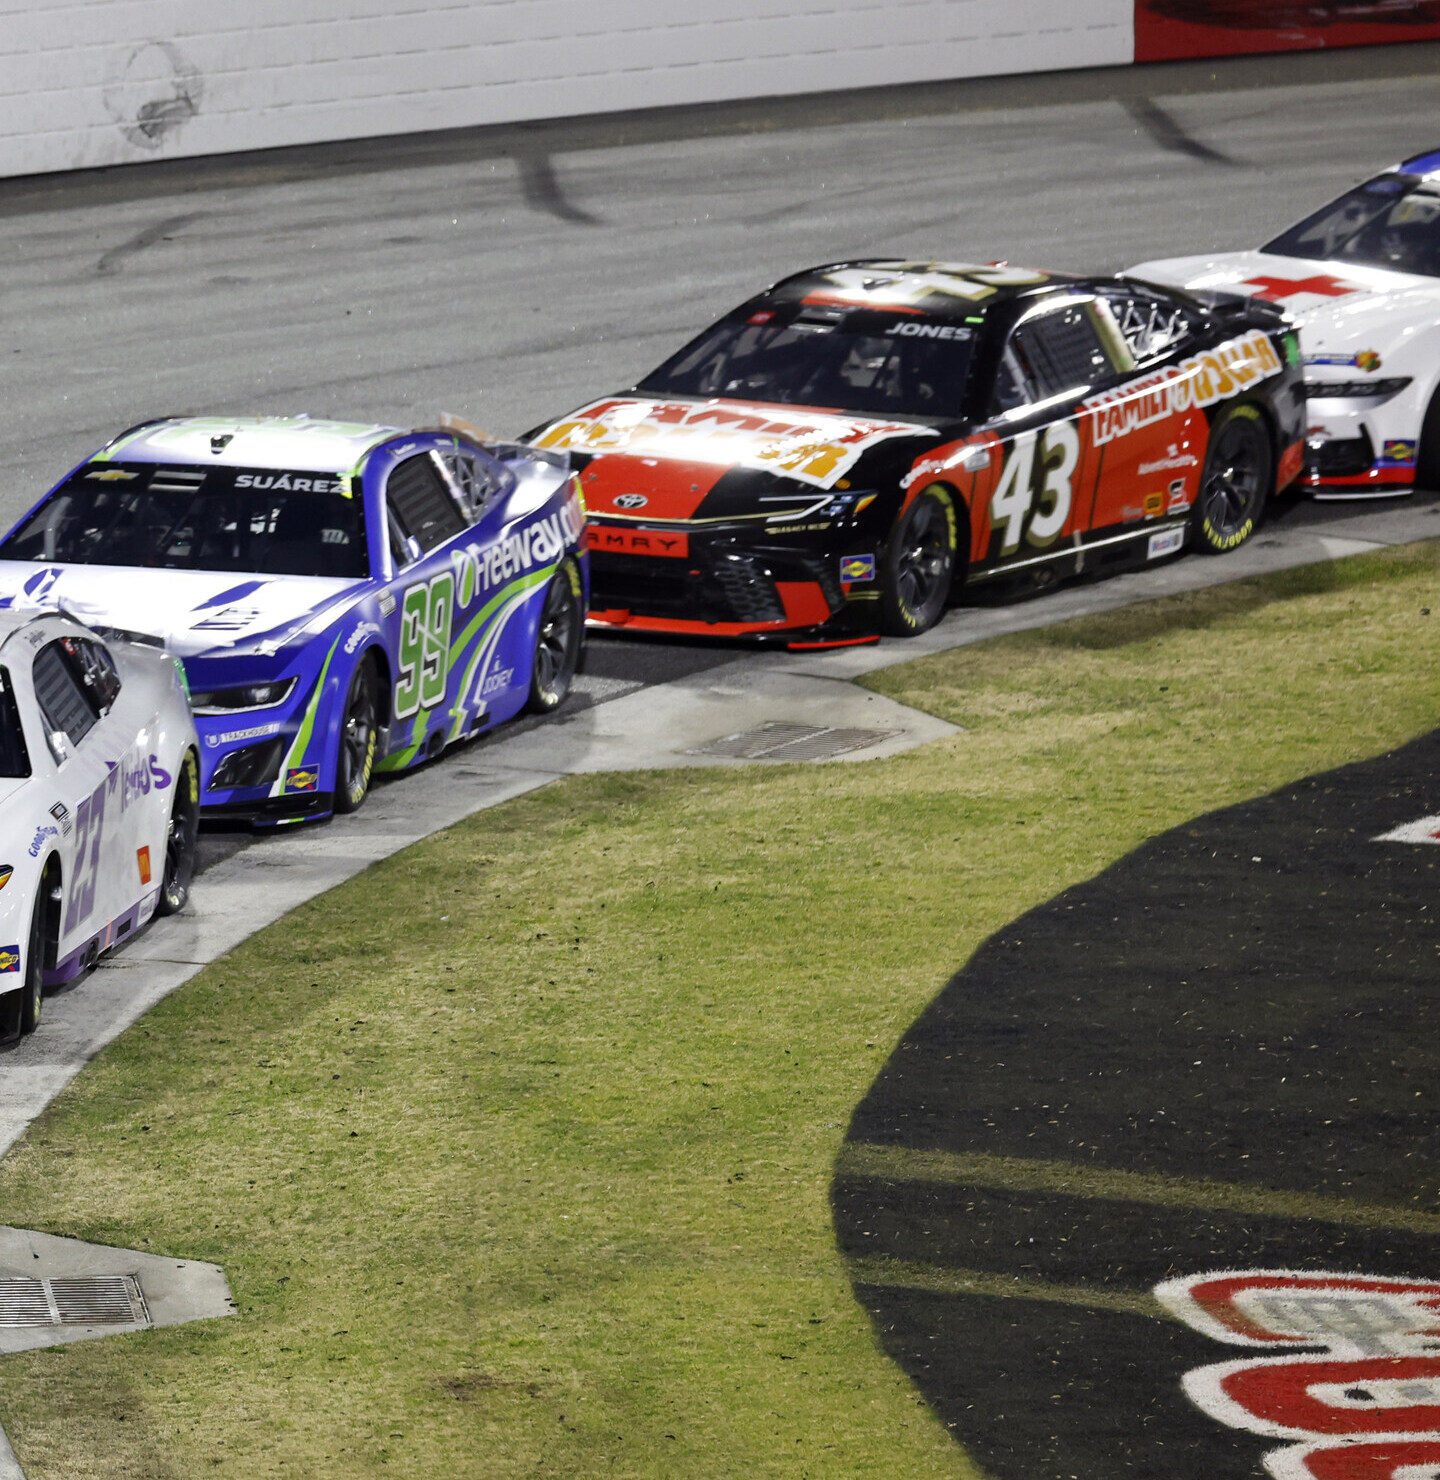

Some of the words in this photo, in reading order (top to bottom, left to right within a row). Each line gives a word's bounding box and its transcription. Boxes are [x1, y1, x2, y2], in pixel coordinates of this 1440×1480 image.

[885, 322, 972, 341] JONES
[991, 419, 1080, 550] 43
[587, 532, 680, 551] AMRY
[394, 571, 454, 720] 99
